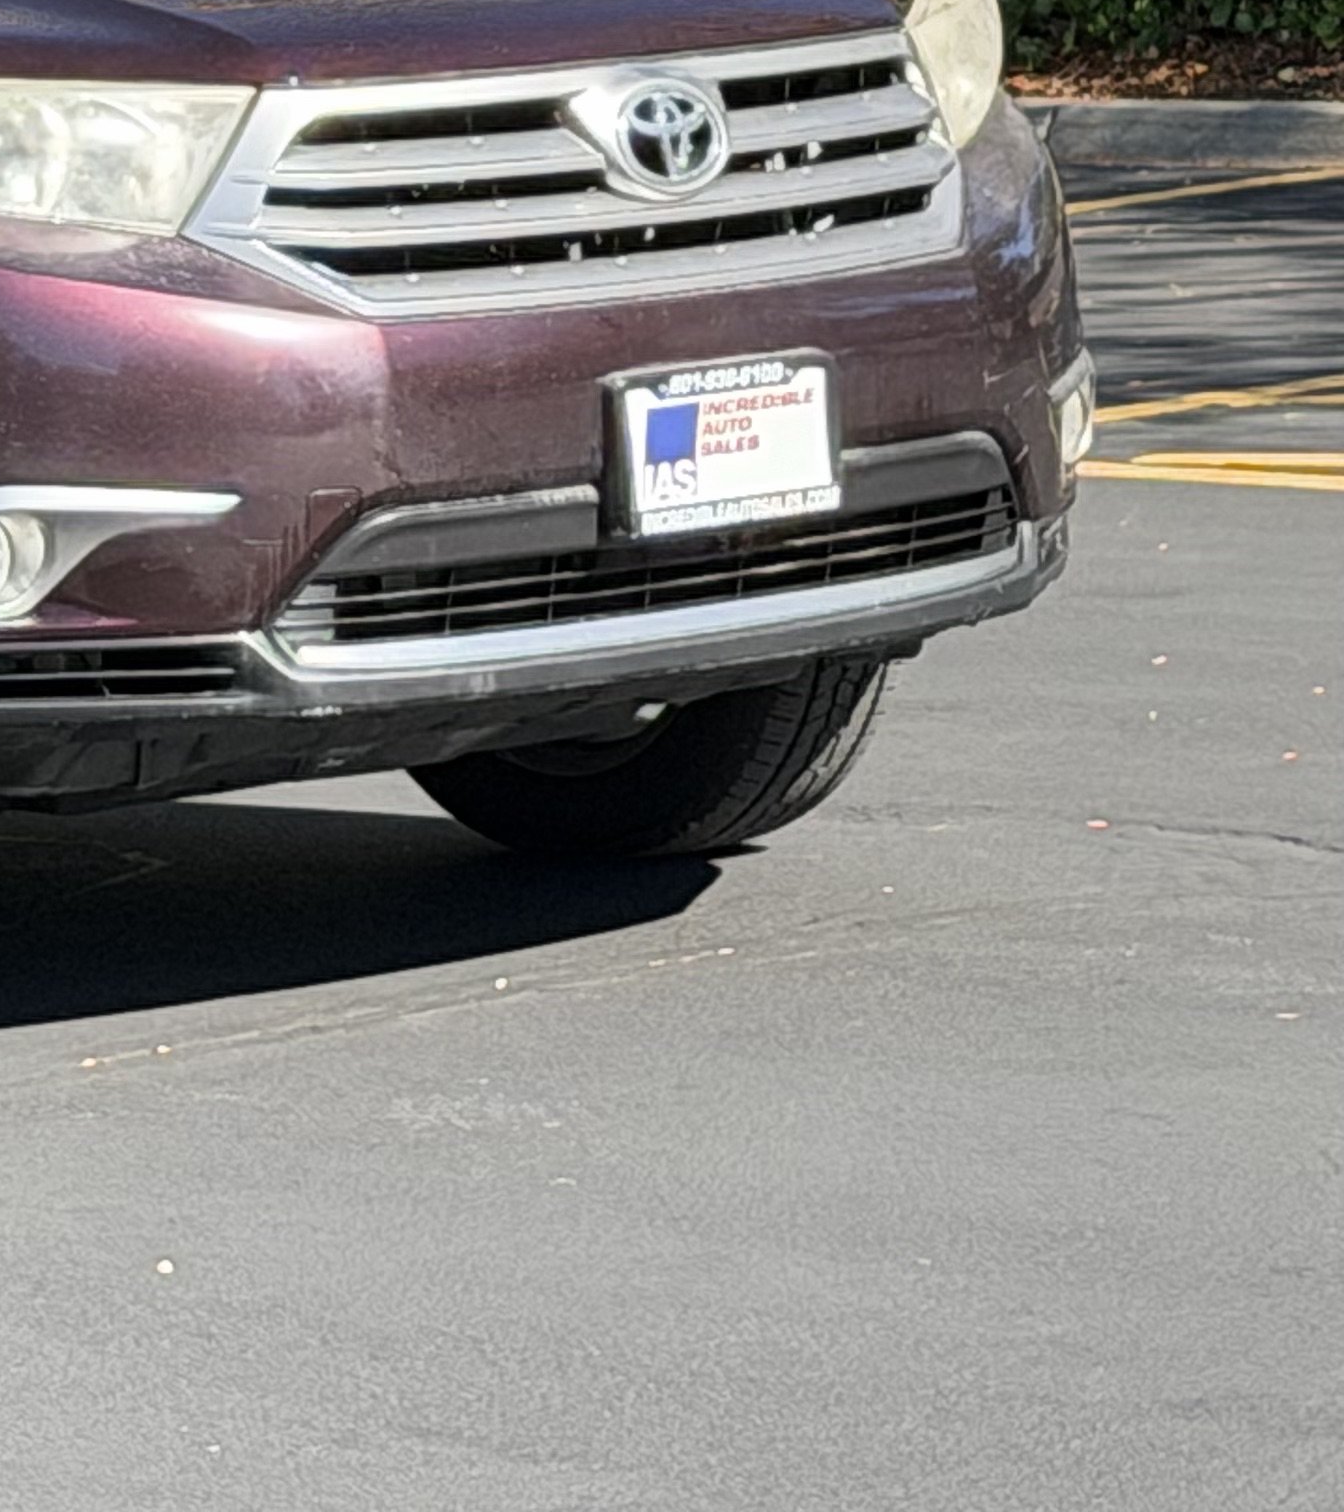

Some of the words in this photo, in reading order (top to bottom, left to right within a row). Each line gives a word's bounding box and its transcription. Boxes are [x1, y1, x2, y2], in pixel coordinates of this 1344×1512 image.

[702, 387, 815, 416] INCREDIBLE
[702, 416, 752, 437] AUTO
[701, 434, 760, 457] SALES
[644, 457, 699, 503] IAS
